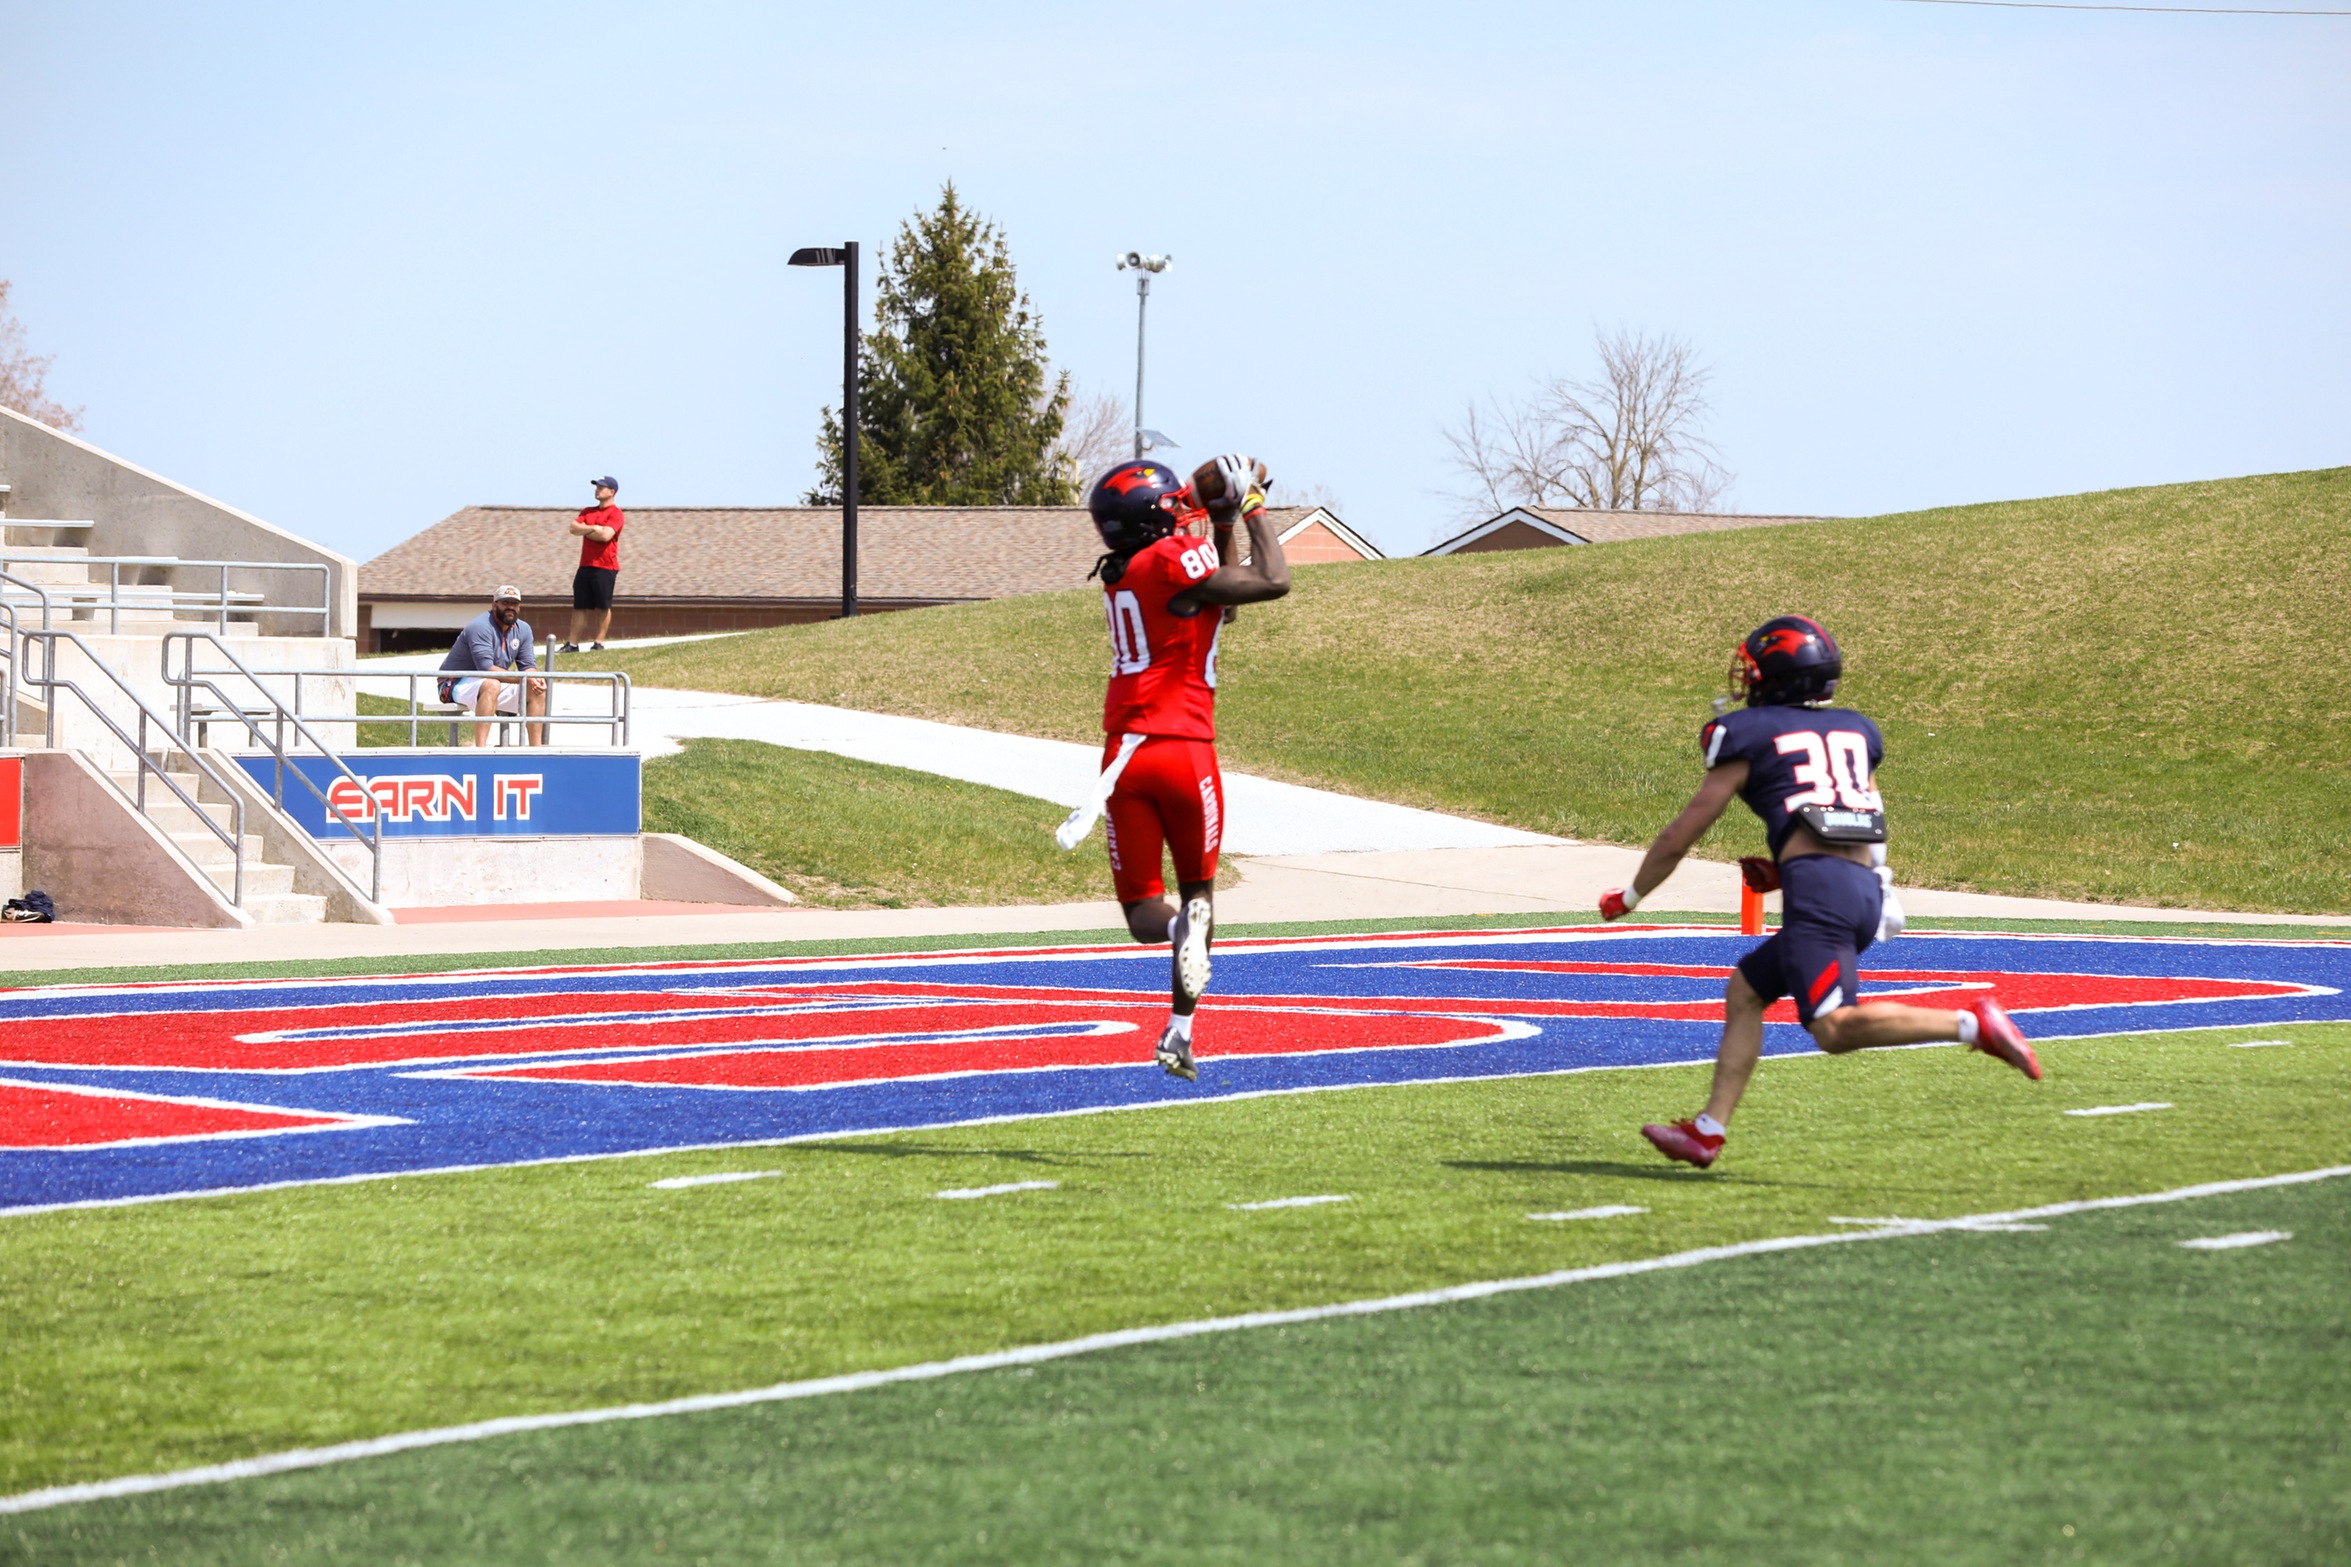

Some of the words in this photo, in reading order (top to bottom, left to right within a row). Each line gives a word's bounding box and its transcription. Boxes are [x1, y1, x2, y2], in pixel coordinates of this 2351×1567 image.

[1179, 541, 1219, 580] 80
[1773, 730, 1880, 815] 30
[326, 774, 477, 823] EARN
[493, 773, 543, 820] IT
